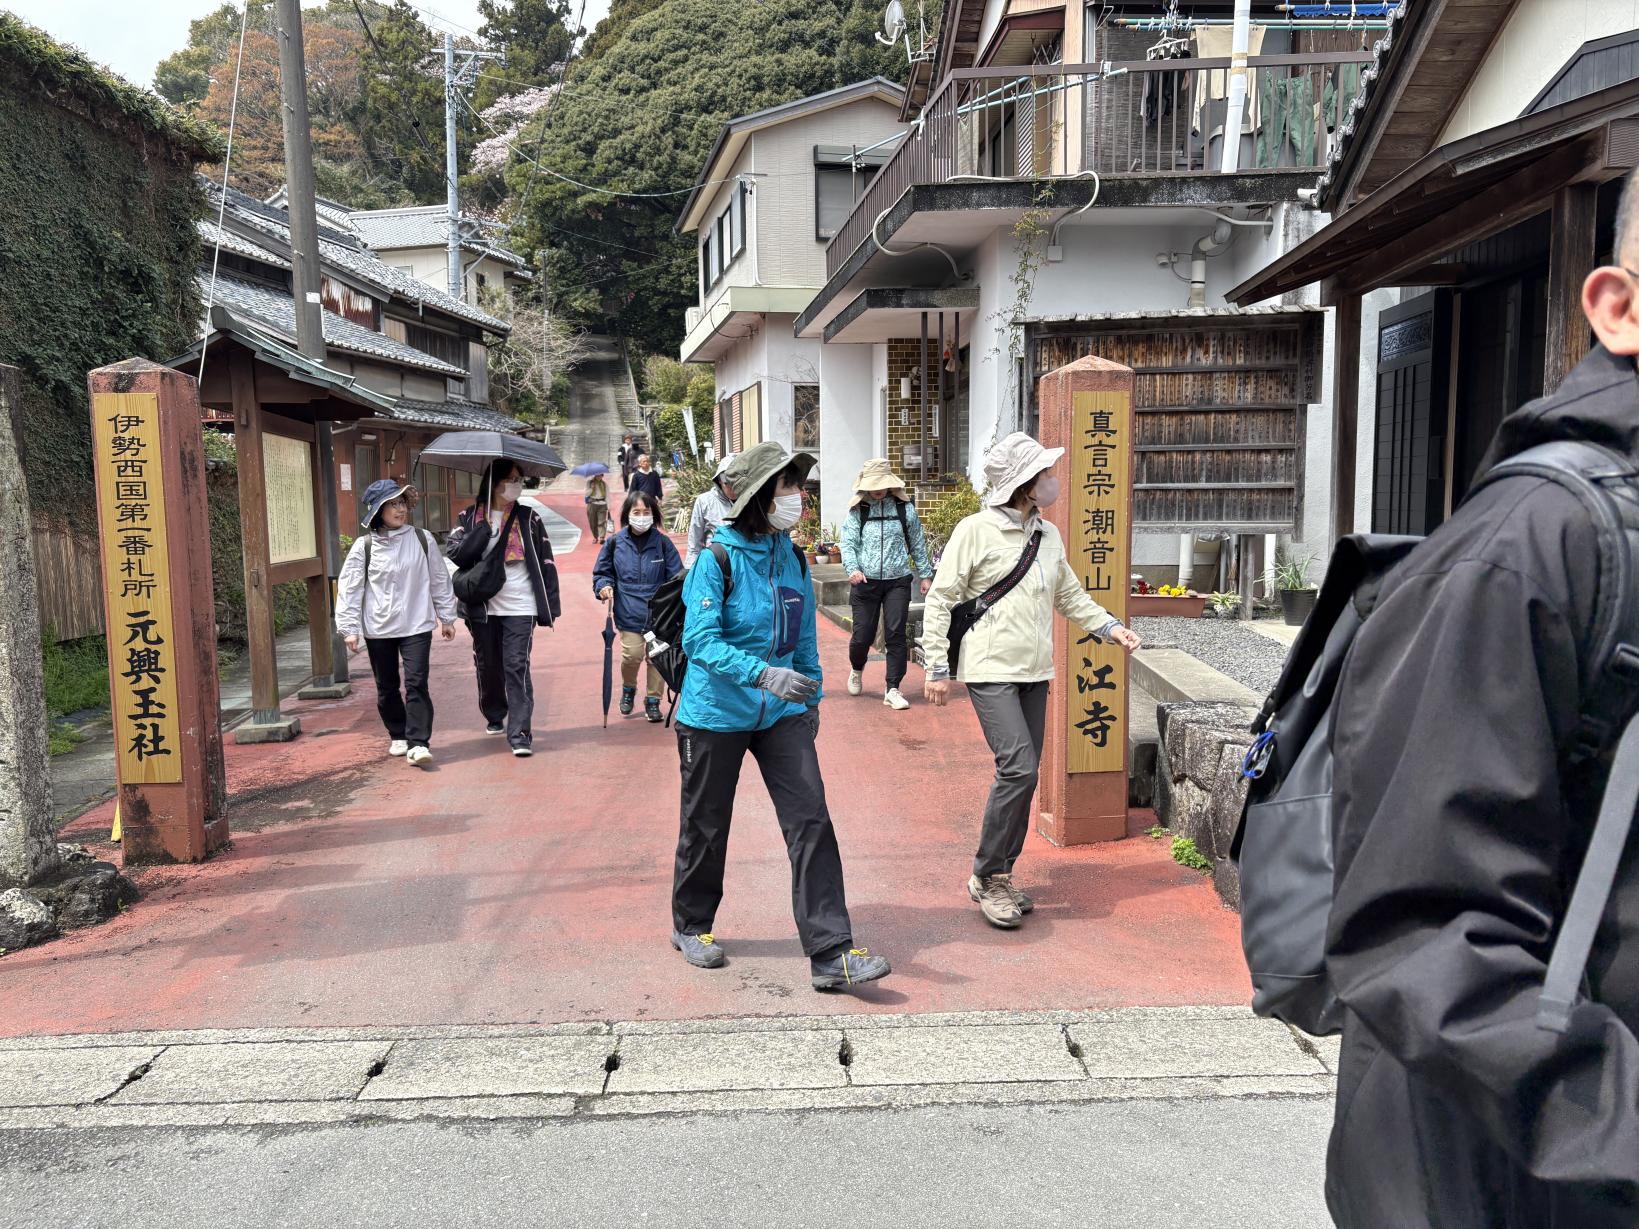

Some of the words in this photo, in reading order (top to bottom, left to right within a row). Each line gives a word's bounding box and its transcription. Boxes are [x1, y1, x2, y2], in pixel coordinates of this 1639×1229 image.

[108, 413, 157, 599] 伊勢西国第一番札所
[1083, 410, 1117, 497] 真言宗
[1083, 508, 1116, 591] 潮音山
[121, 610, 171, 762] 元興玉社
